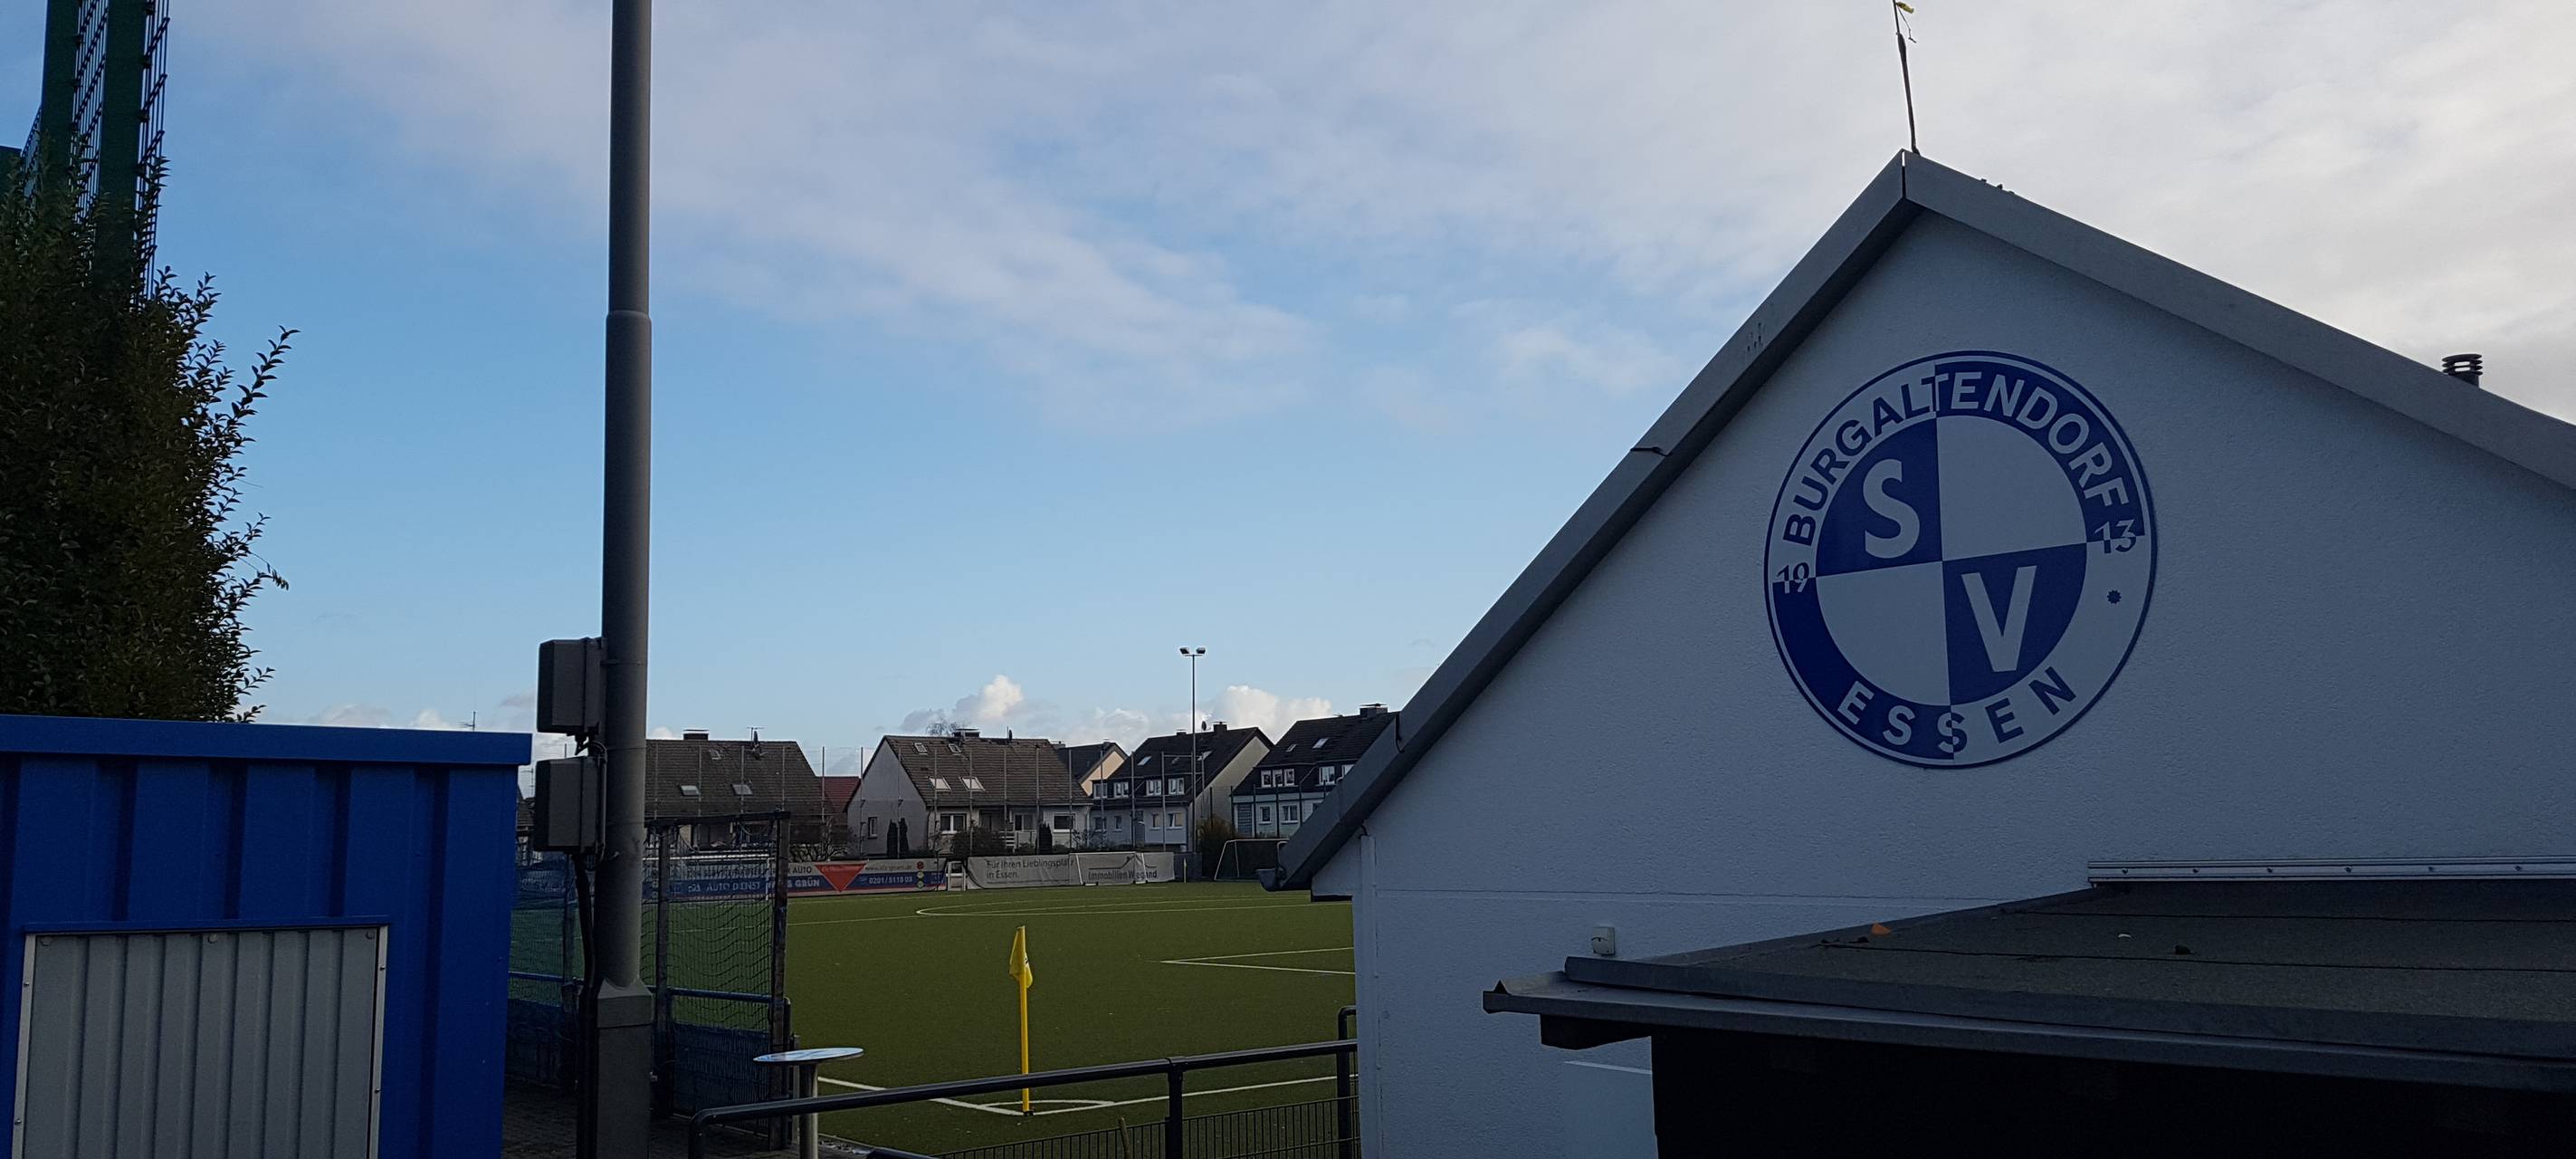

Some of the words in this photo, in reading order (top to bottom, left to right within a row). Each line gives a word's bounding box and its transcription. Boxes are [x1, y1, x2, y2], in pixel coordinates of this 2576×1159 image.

[1782, 371, 2130, 546] BURGALTENDORF
[2093, 518, 2137, 554] 13
[1776, 561, 1811, 595] 19
[1863, 458, 1920, 559] S
[1961, 565, 2037, 673] V
[1837, 666, 2076, 754] ESSEN
[793, 866, 812, 874] AUTO
[795, 876, 820, 887] GRÜN
